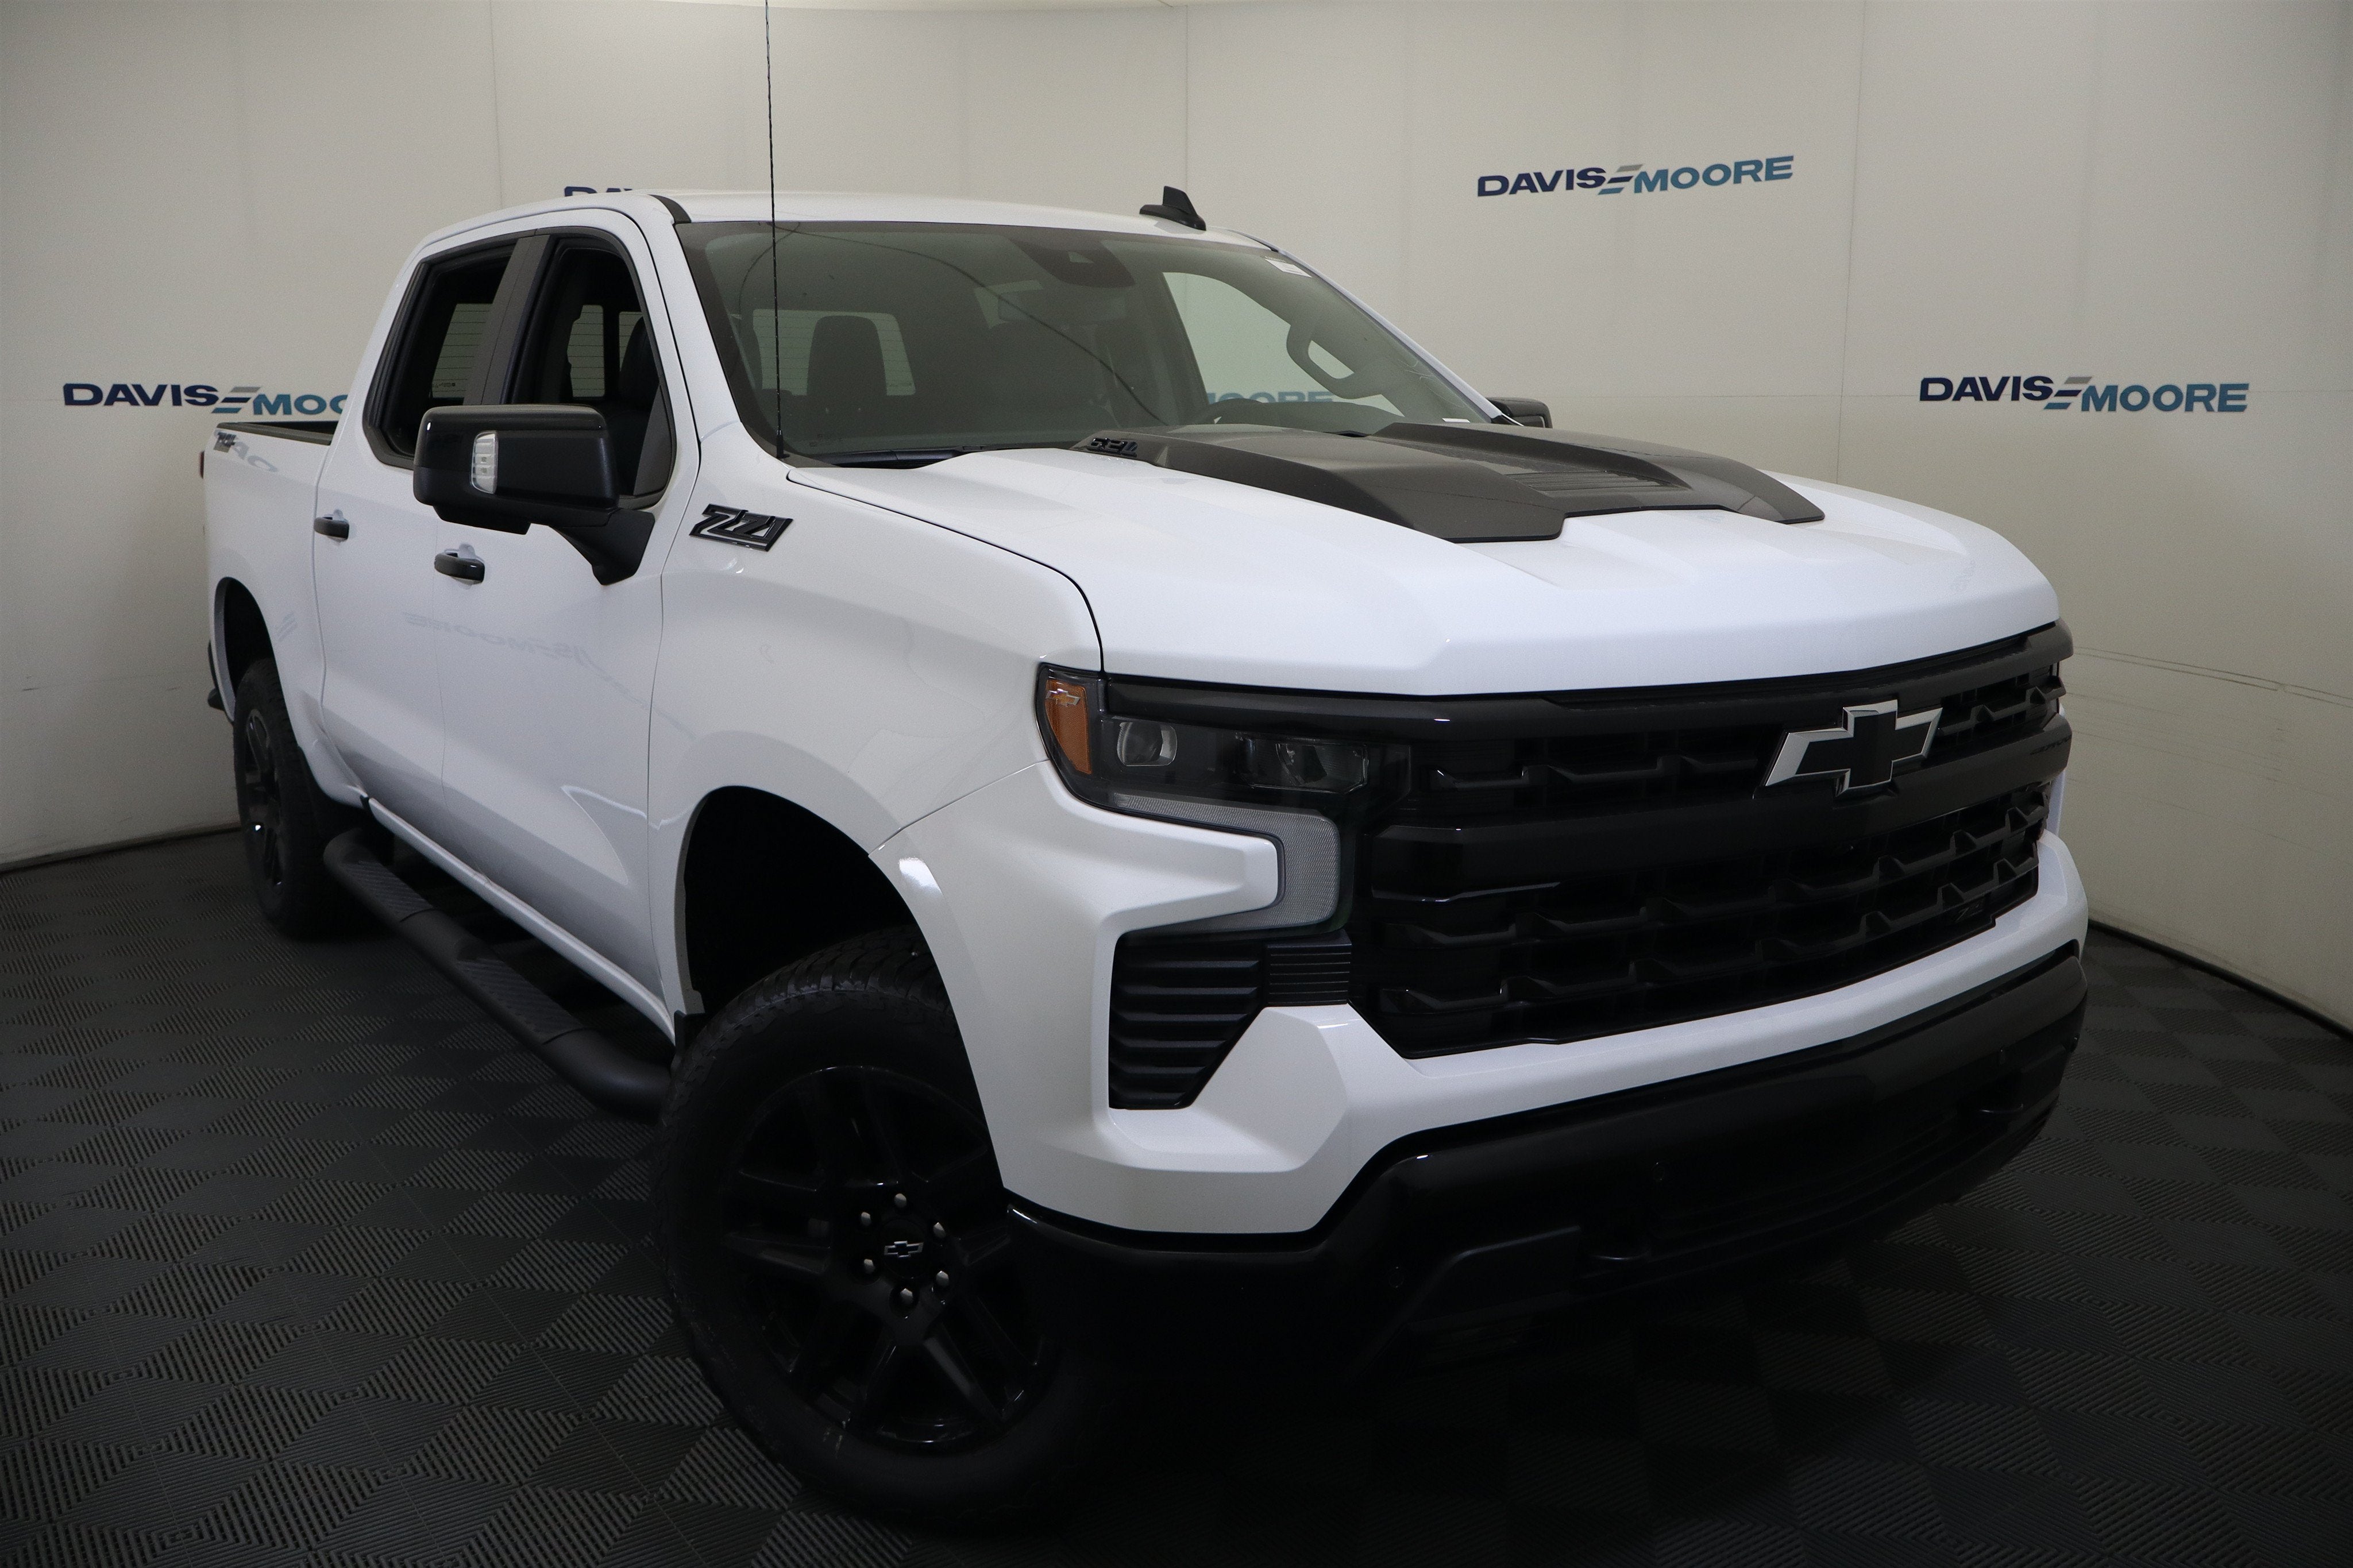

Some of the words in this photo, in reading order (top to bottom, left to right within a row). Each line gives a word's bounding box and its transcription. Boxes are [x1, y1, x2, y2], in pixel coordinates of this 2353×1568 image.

[1478, 167, 1607, 197] DAVIS
[1634, 156, 1794, 194] MOORE
[63, 383, 219, 407] DAVIS
[1919, 376, 2054, 401] DAVIS
[2081, 383, 2249, 412] MOORE
[689, 504, 793, 552] Z71
